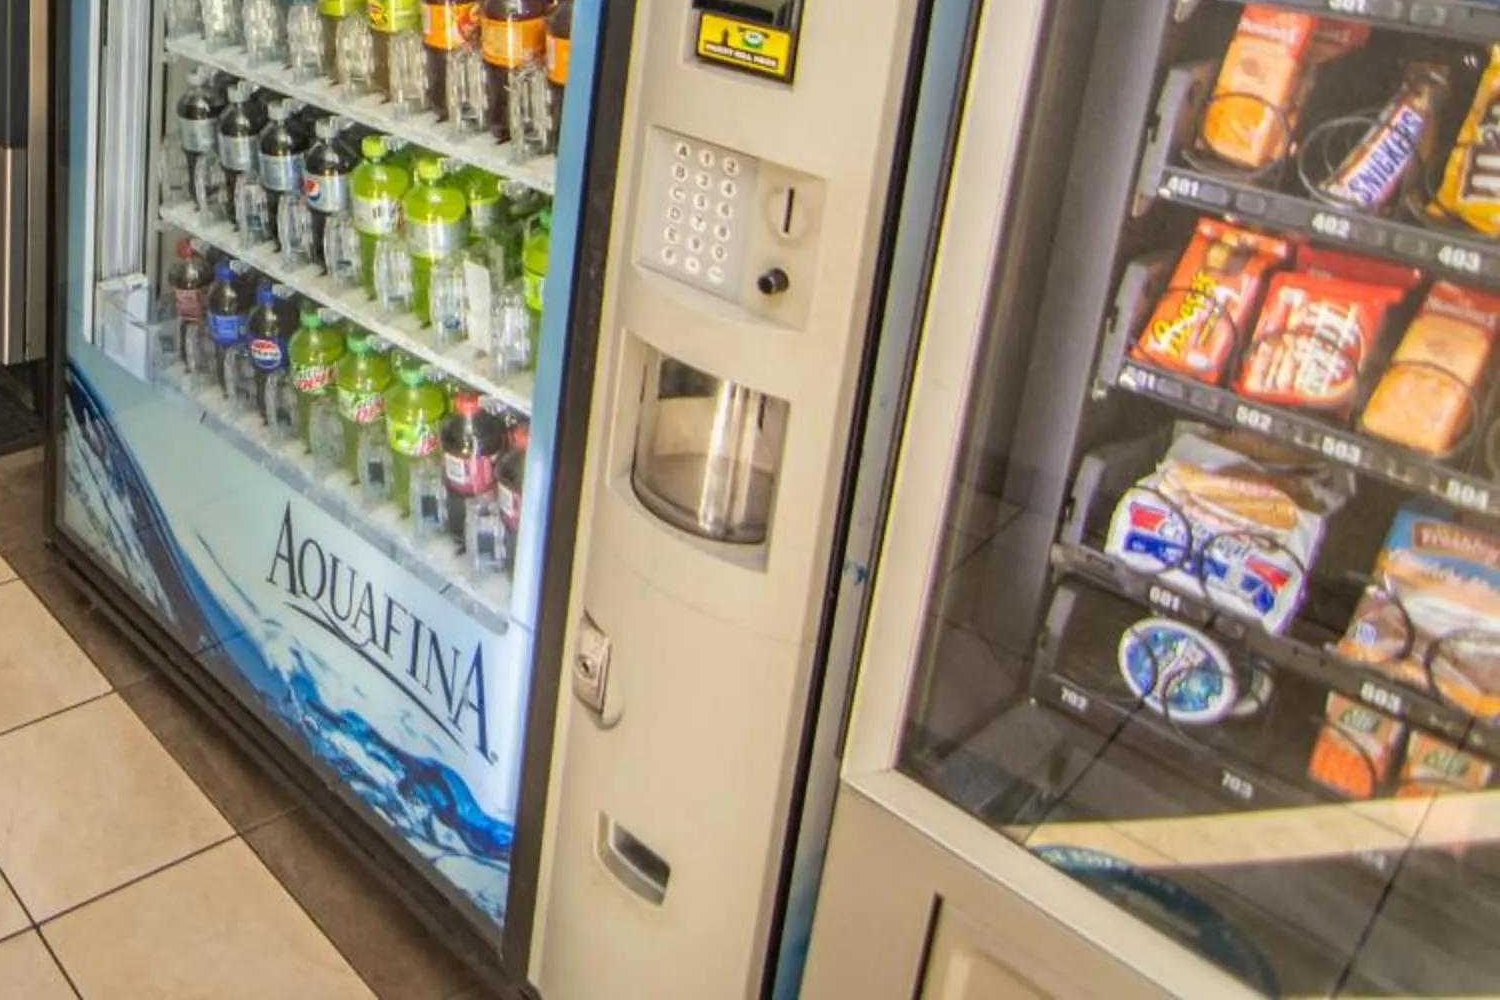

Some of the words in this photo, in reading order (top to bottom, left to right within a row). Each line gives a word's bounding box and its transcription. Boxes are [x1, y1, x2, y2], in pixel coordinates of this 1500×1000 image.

[1167, 176, 1199, 197] 401
[1311, 212, 1350, 238] 402
[1438, 245, 1481, 272] 403
[1236, 405, 1273, 431] 502
[1322, 437, 1362, 463] 503
[1447, 480, 1490, 508] 504
[265, 498, 496, 767] AQUAFINA
[1221, 771, 1254, 800] 703
